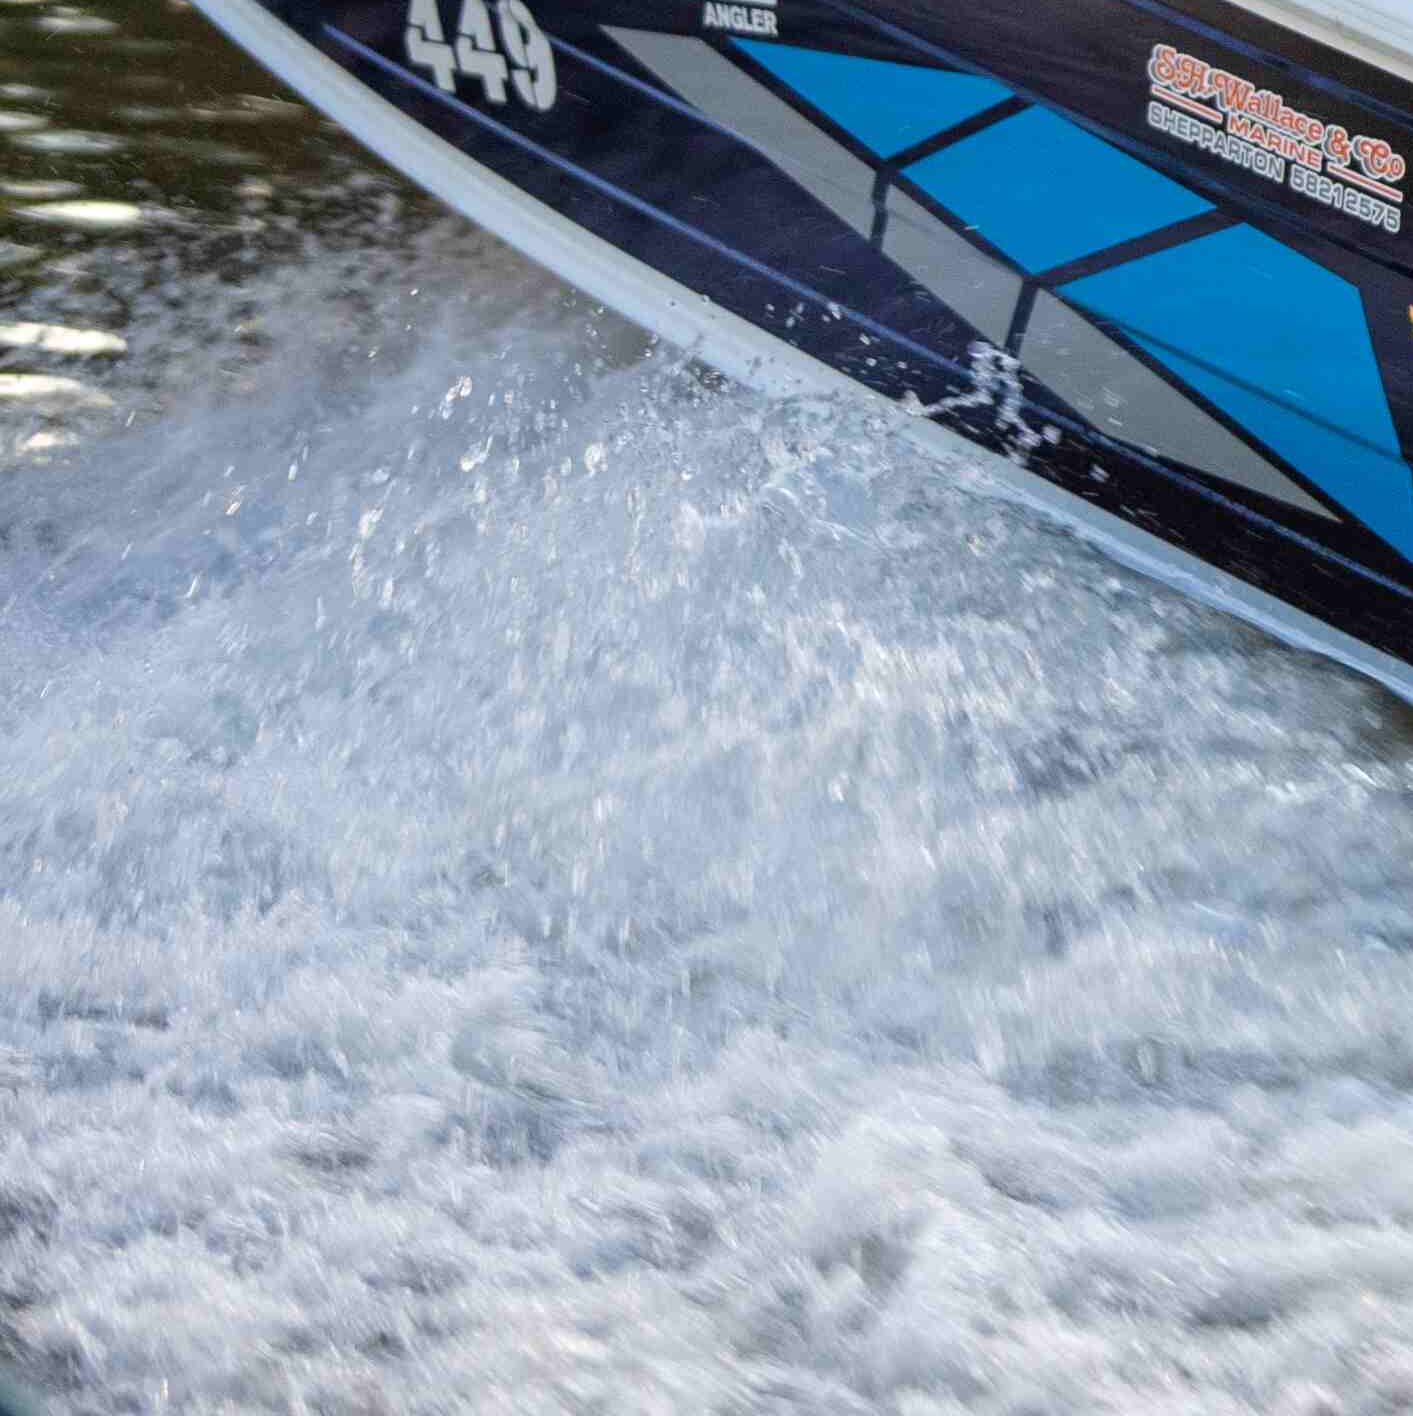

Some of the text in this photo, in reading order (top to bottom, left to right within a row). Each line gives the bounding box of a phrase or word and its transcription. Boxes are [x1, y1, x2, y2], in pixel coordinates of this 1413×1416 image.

[703, 1, 778, 36] ANGLER
[1148, 101, 1285, 182] SHEPPARTON
[1213, 69, 1324, 145] Wallace
[1322, 125, 1350, 166] &
[1352, 135, 1405, 182] Co
[1227, 111, 1322, 173] MARINE
